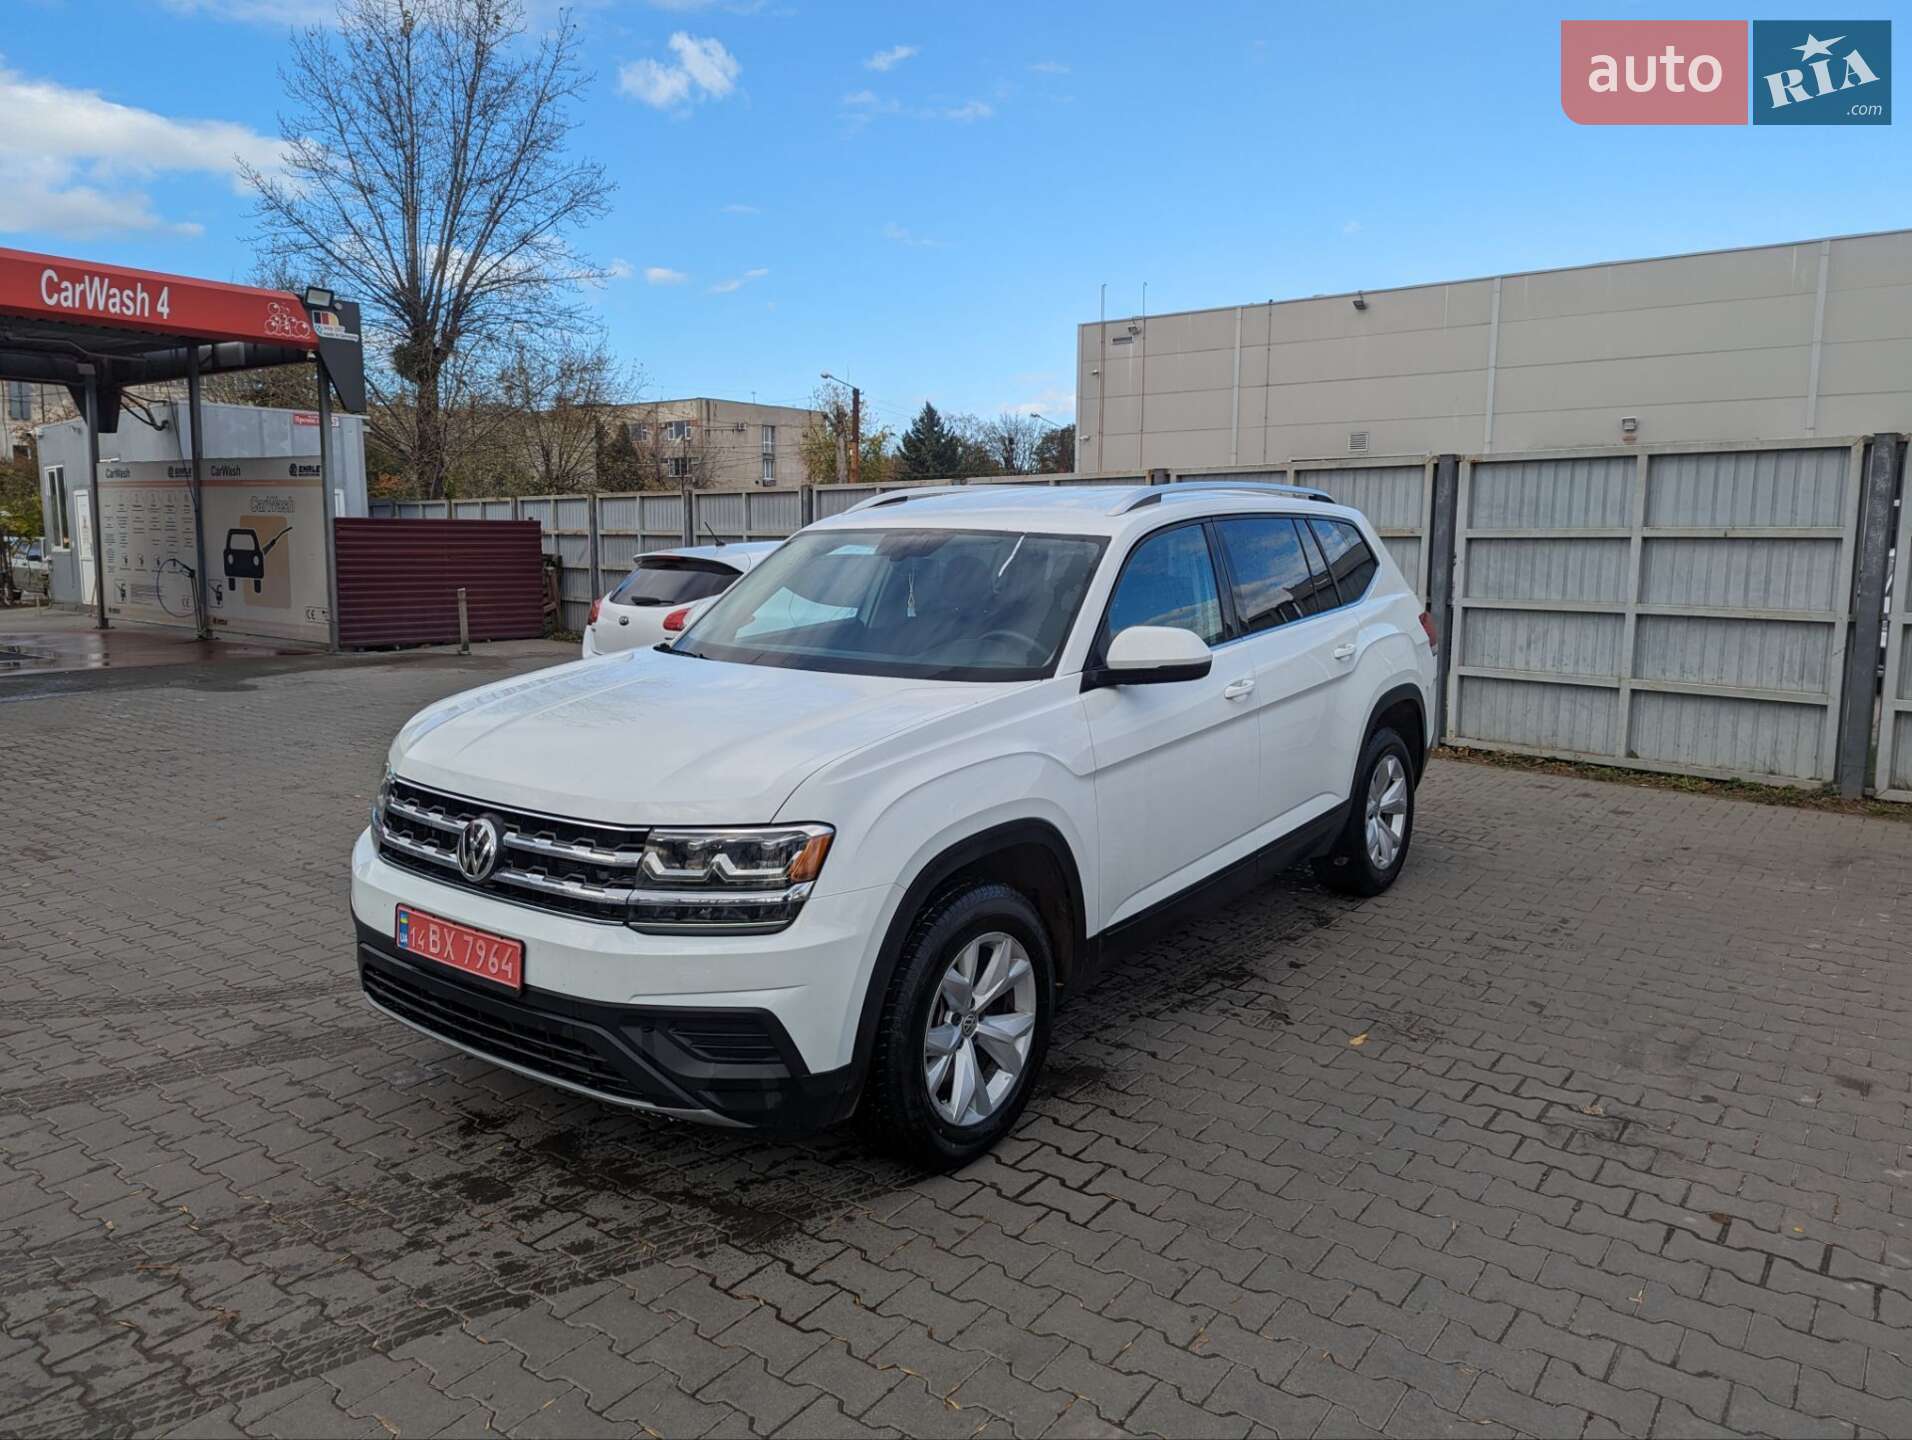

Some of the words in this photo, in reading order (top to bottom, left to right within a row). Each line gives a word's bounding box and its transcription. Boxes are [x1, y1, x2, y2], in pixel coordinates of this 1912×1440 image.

[41, 268, 150, 317] CarWash
[157, 286, 170, 319] 4
[211, 465, 241, 477] CarWash
[249, 496, 295, 513] CarWash
[464, 936, 513, 979] 7964
